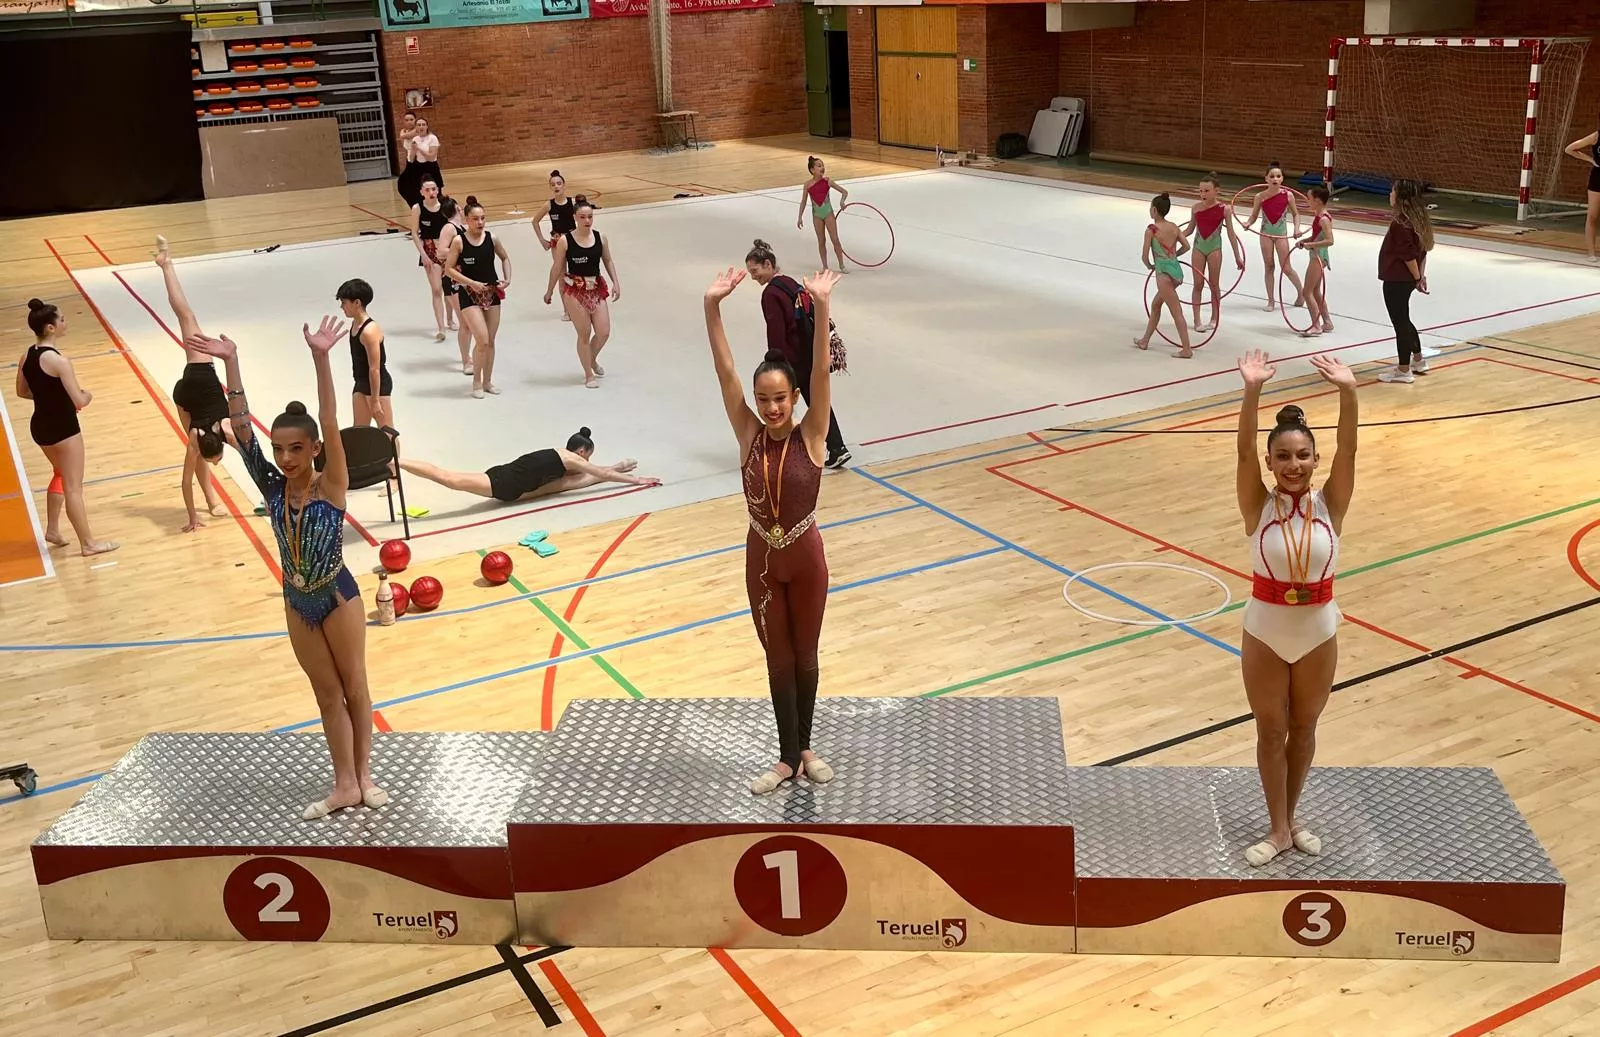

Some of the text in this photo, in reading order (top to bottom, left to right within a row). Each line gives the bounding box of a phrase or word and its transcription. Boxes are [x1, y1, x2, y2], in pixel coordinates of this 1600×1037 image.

[684, 0, 693, 8] 16
[762, 850, 801, 919] 1
[253, 872, 300, 922] 2
[372, 912, 432, 927] Teruel
[1298, 902, 1331, 940] 3
[876, 920, 940, 935] Teruel
[1395, 932, 1450, 945] Teruel
